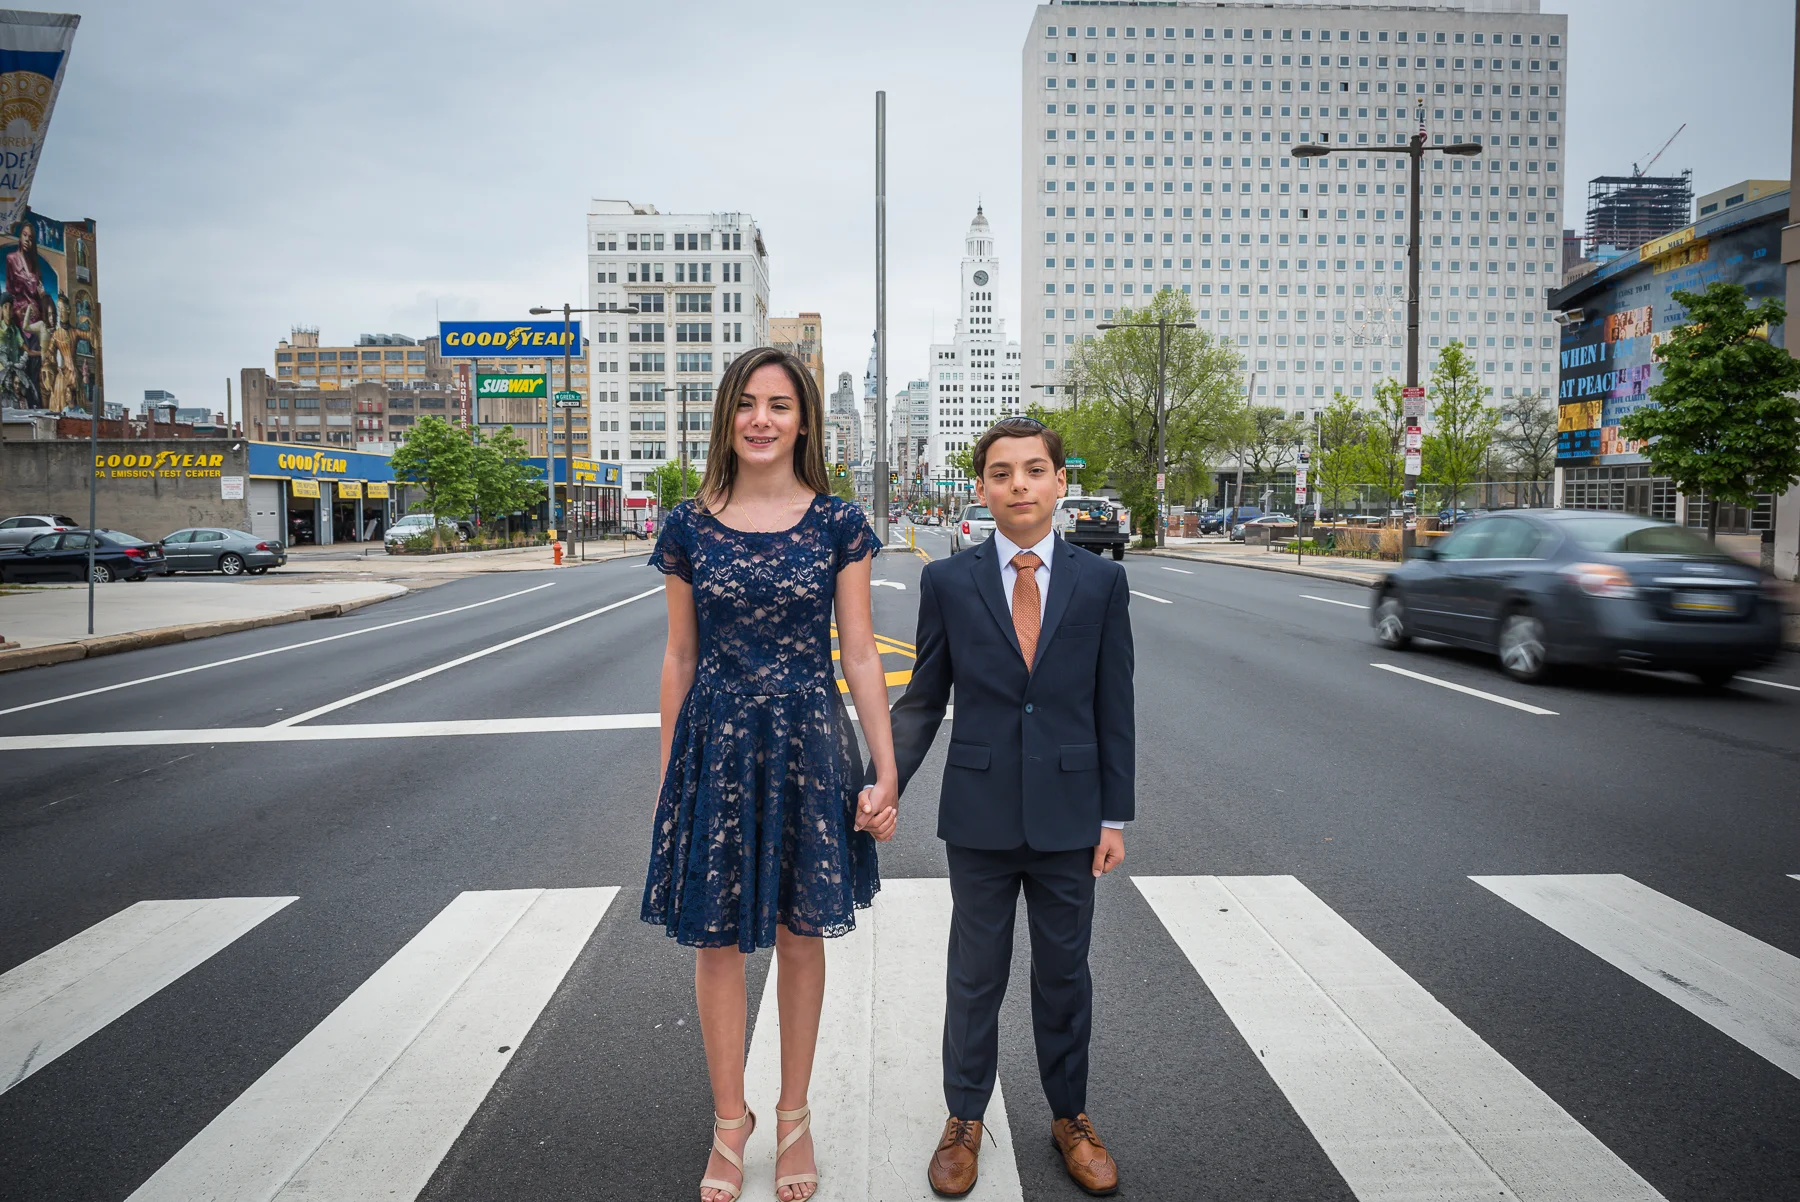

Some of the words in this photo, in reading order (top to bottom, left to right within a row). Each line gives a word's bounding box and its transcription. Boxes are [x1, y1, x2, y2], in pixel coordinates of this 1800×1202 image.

[446, 331, 575, 346] GOODYEAR
[1560, 343, 1598, 370] WHEN
[1600, 342, 1606, 361] I
[1612, 337, 1634, 359] AM
[479, 377, 543, 393] SUBWAY
[1559, 378, 1575, 399] AT
[460, 374, 468, 429] INQUIRER
[1615, 404, 1631, 414] FOCUS
[95, 453, 225, 468] GOODYEAR
[278, 453, 347, 473] GOODYEAR
[111, 470, 155, 478] EMISSION
[160, 470, 182, 478] TEST
[185, 470, 222, 478] CENTER
